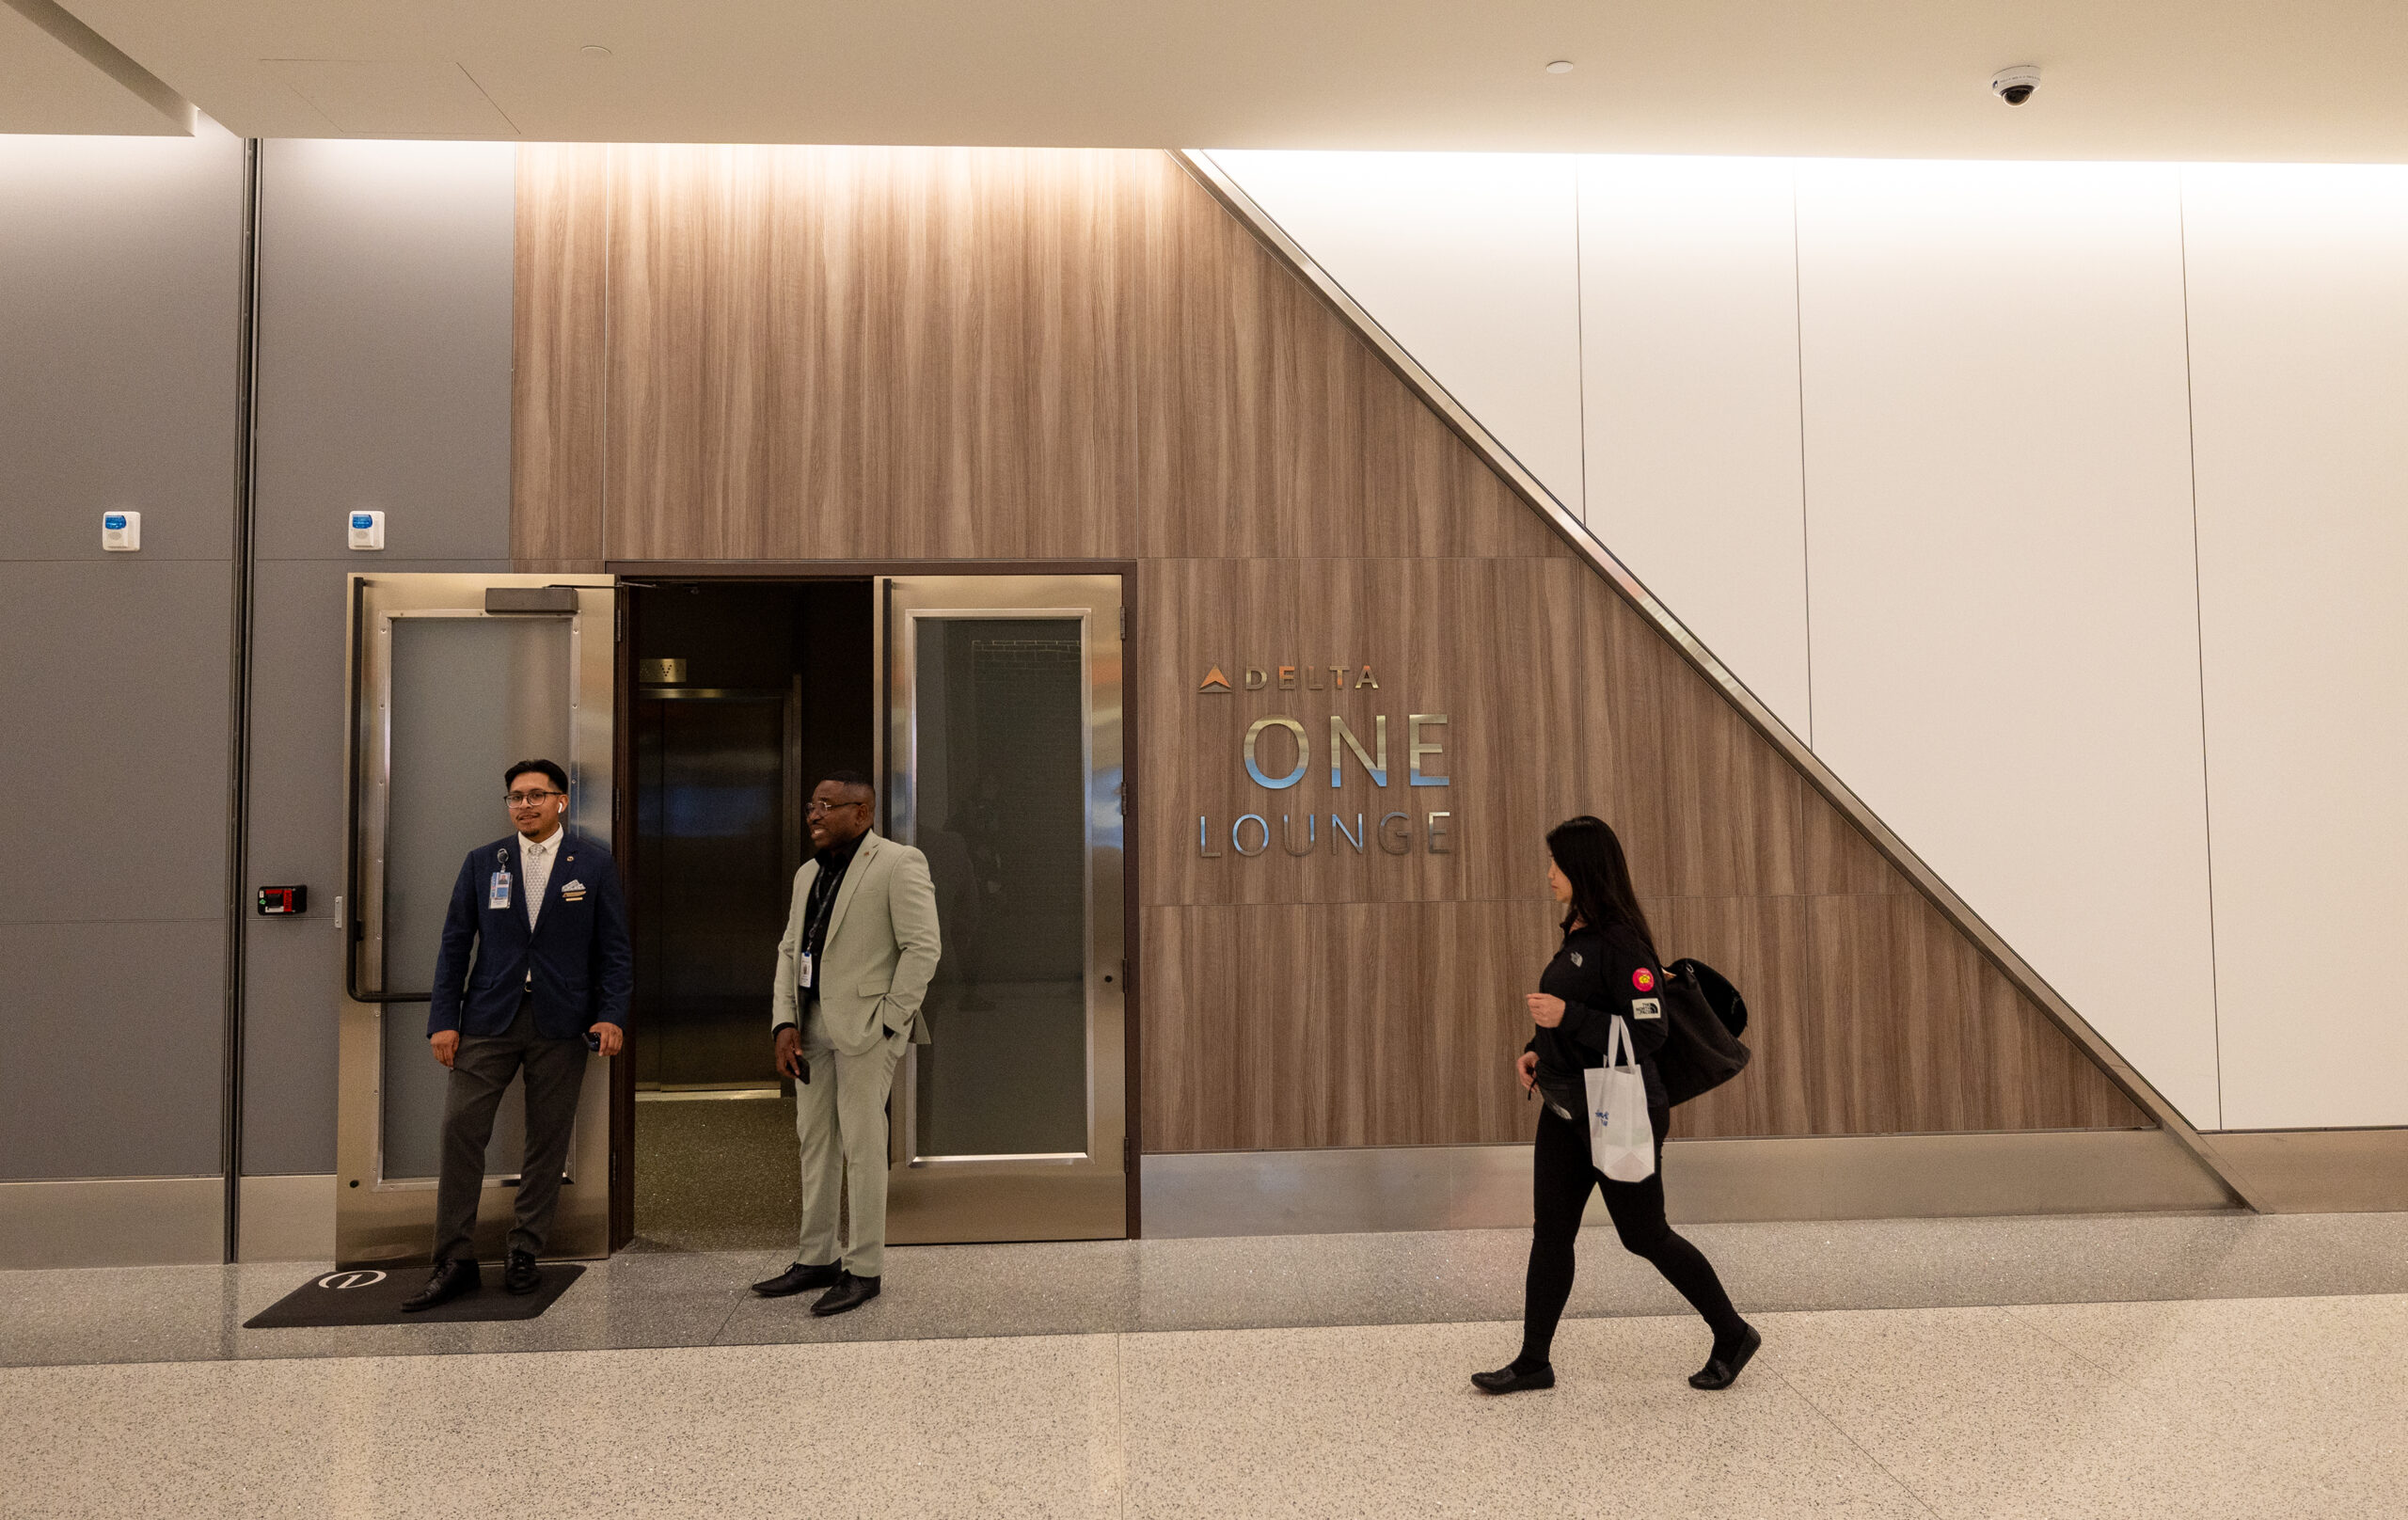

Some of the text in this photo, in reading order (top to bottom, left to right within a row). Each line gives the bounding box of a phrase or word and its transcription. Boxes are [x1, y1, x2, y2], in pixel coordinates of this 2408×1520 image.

[1245, 665, 1379, 690] DELTA
[1244, 714, 1450, 789] ONE
[1200, 812, 1450, 857] LOUNGE
